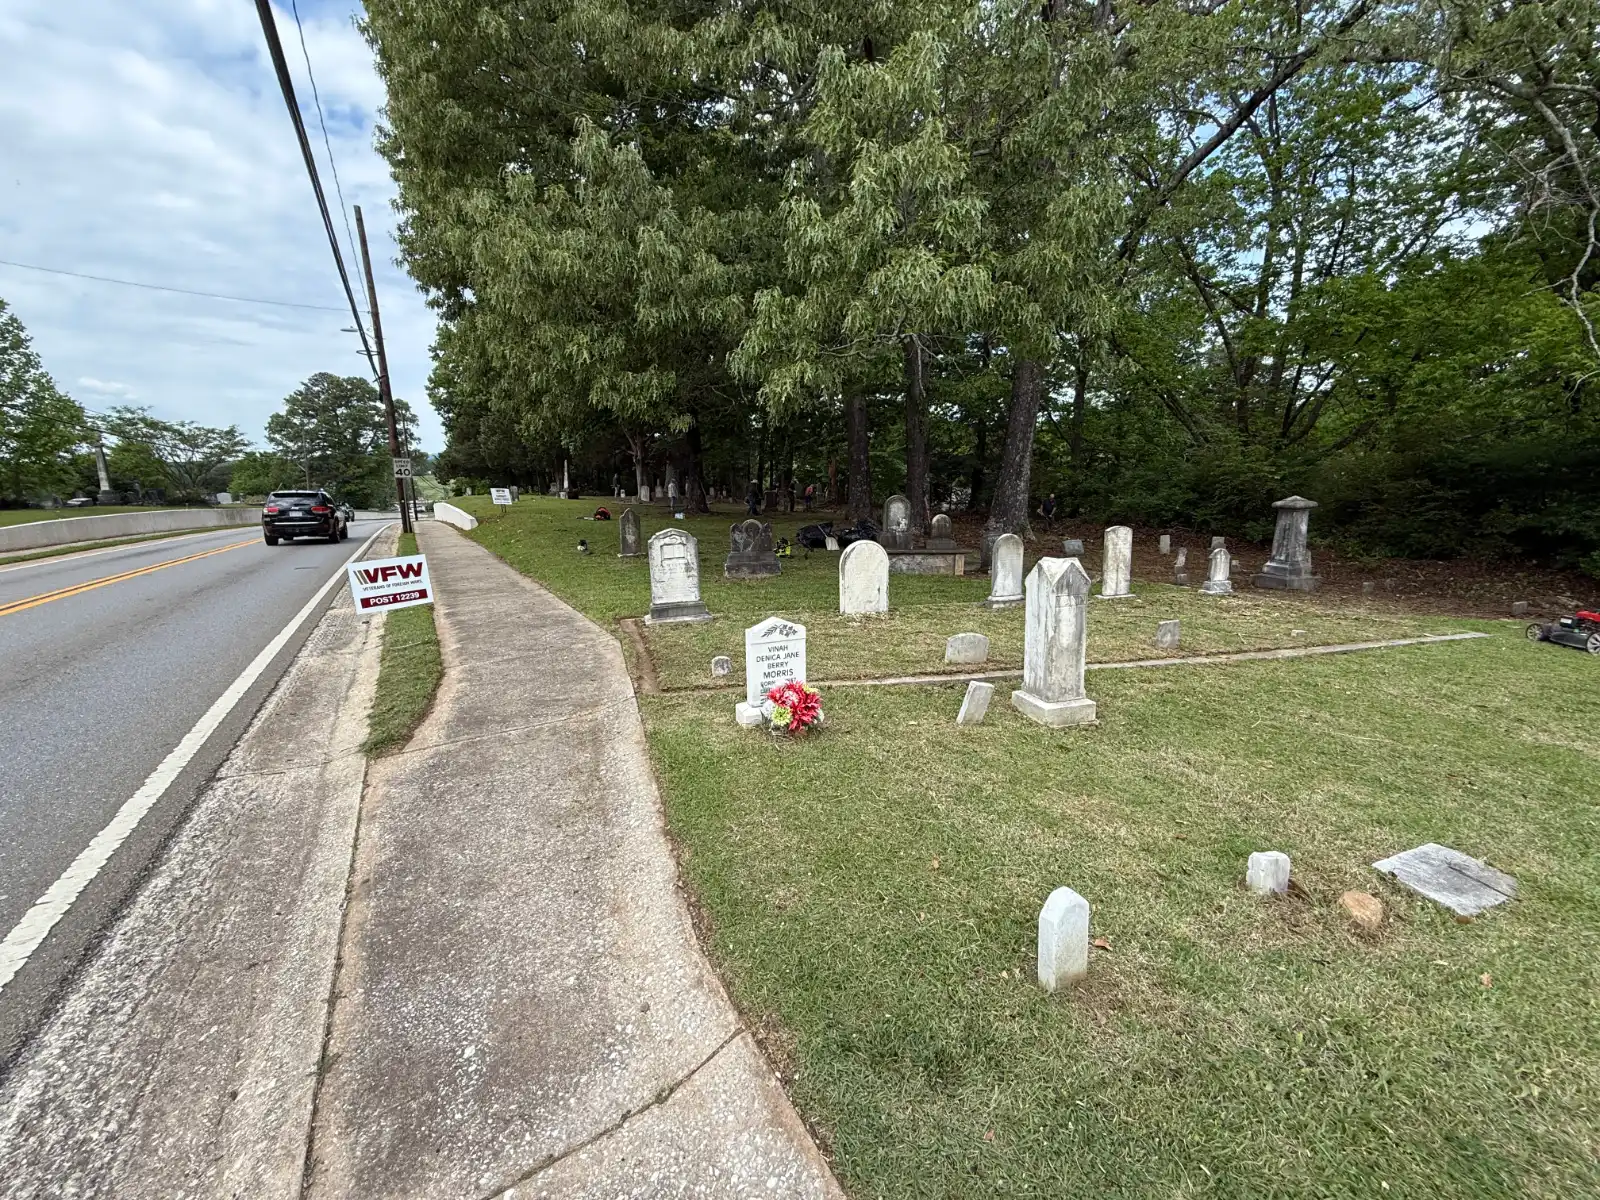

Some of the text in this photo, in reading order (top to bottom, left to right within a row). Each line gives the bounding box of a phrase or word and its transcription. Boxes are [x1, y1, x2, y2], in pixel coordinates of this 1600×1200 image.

[363, 562, 423, 584] VFW
[370, 592, 420, 605] POST 12239
[756, 654, 781, 662] DENICA
[767, 661, 789, 669] BERRY
[763, 668, 794, 679] MORRIS
